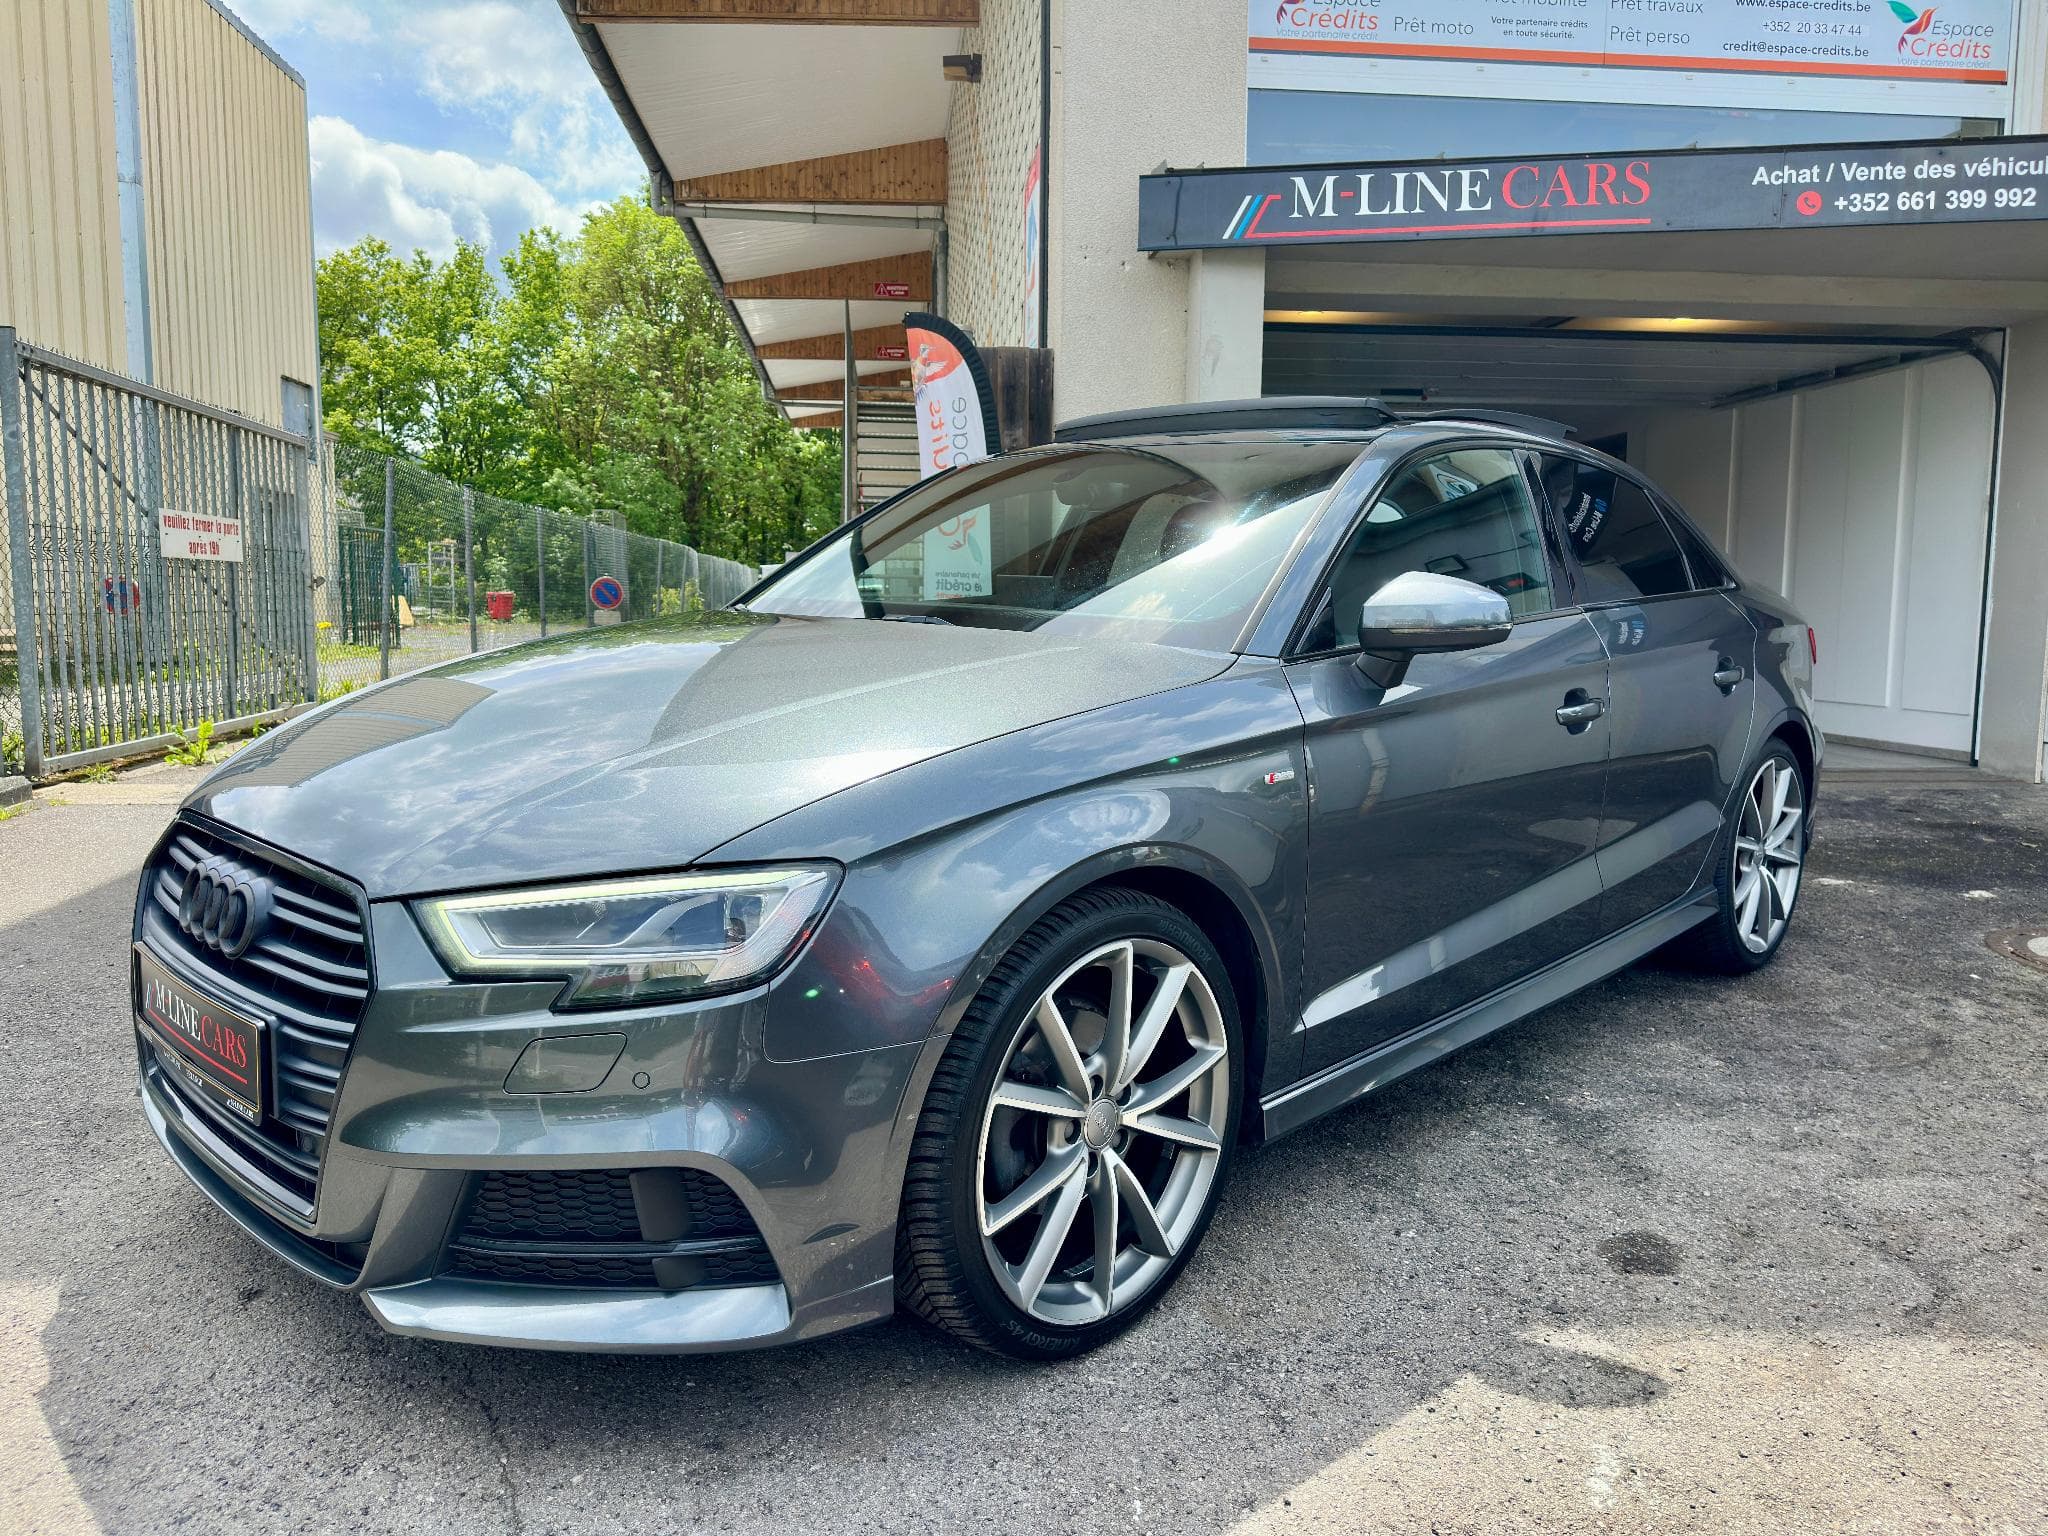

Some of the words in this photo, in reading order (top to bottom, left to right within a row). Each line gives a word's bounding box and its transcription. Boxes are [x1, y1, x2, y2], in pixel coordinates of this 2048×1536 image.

[1647, 0, 1704, 13] travaux
[1735, 0, 1871, 12] www.espace-credits.be
[1291, 7, 1379, 30] Crédits
[1394, 16, 1426, 33] Prêt
[1431, 21, 1474, 35] moto
[1491, 16, 1514, 25] Votre
[1516, 18, 1558, 28] partenaire
[1560, 19, 1588, 28] crédits
[1762, 20, 1790, 32] +352
[1797, 22, 1811, 33] 20
[1814, 23, 1828, 34] 33
[1831, 24, 1845, 35] 47
[1848, 25, 1862, 35] 44
[1277, 28, 1299, 37] Votre
[1302, 30, 1350, 39] partenaire
[1610, 25, 1642, 42] Prêt
[1646, 30, 1690, 46] perso
[1931, 20, 1994, 39] Espace
[1722, 41, 1869, 57] credit@espace-credits.be
[1911, 38, 1992, 59] Crédits
[1752, 164, 1820, 186] Achat
[1826, 163, 1835, 183] /
[1840, 161, 1907, 182] Vente
[1913, 160, 1956, 179] des
[1289, 168, 1492, 218] M-LINE
[1502, 161, 1650, 210] CARS
[1834, 192, 1889, 213] +352
[1896, 191, 1936, 211] 661
[1945, 189, 1987, 210] 399
[1994, 187, 2037, 208] 992
[163, 514, 190, 530] veuillez
[192, 517, 214, 533] fermer
[155, 978, 200, 1041] M-LINE
[201, 1014, 247, 1069] CARS
